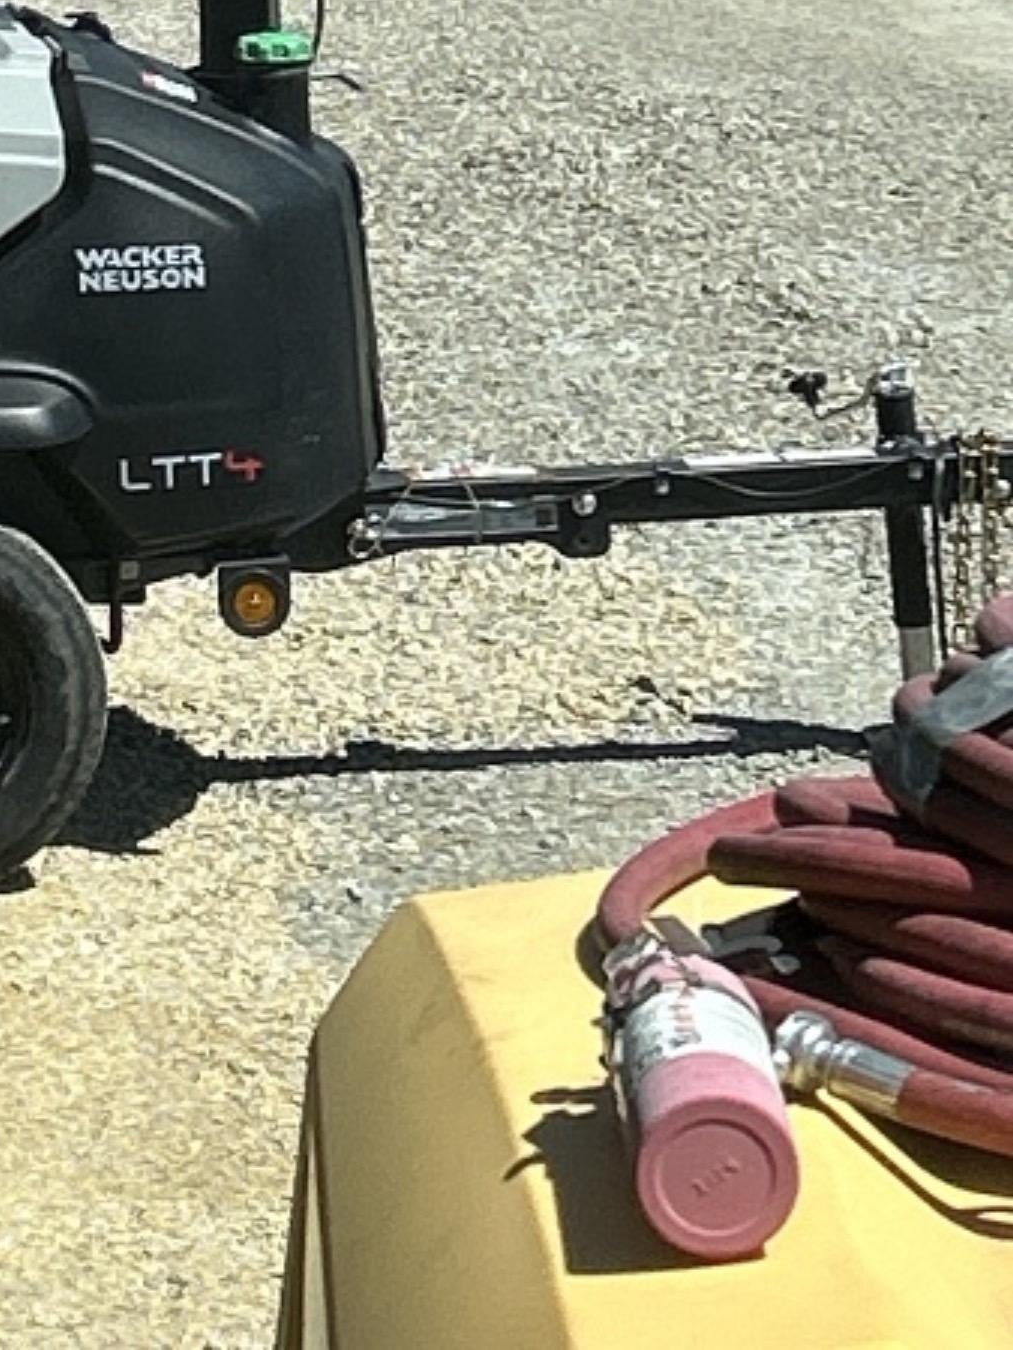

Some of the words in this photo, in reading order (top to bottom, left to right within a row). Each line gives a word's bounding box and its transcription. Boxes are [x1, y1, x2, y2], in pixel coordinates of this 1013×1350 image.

[74, 245, 205, 268] WACKER
[78, 267, 206, 293] NEUSON
[119, 448, 265, 492] LTT4
